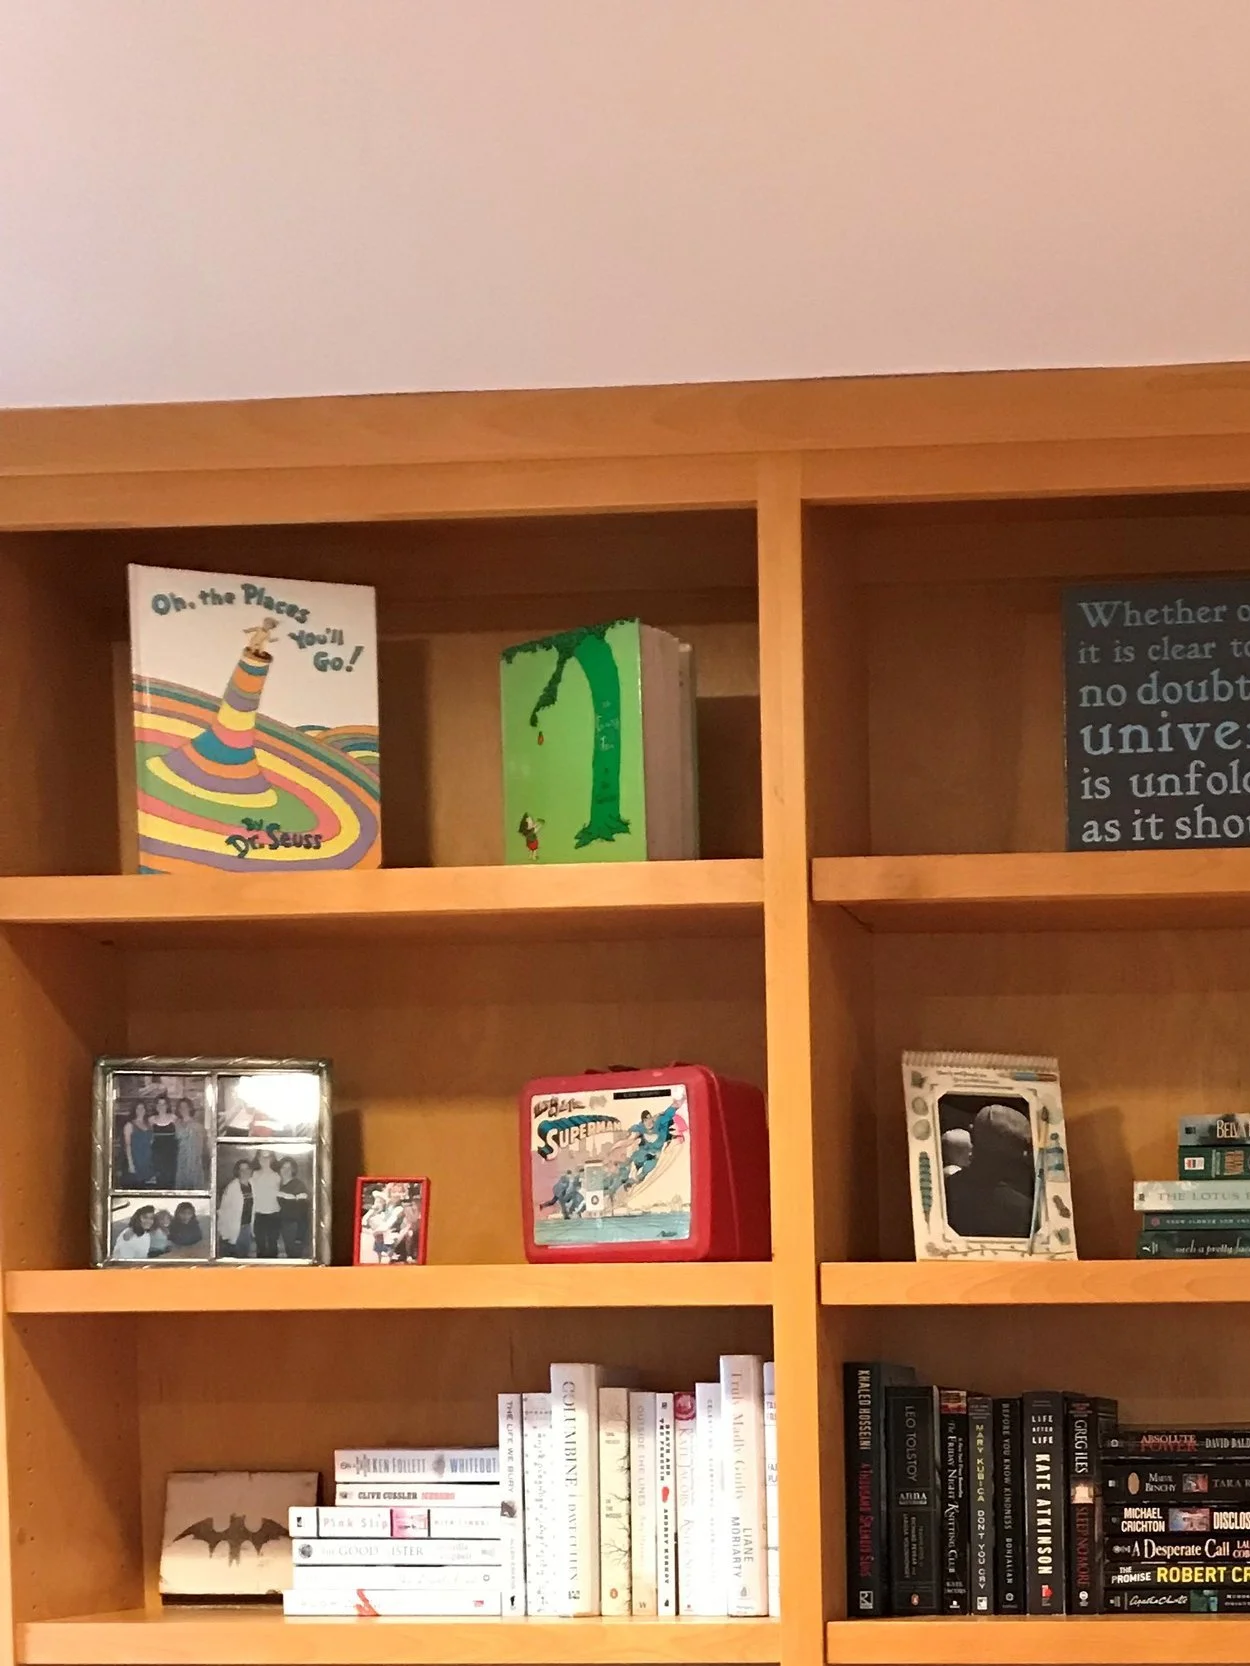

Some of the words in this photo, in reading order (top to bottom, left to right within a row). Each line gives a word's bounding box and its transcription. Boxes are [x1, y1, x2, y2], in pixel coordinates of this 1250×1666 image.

[151, 592, 196, 616] Oh,
[199, 587, 236, 606] the
[240, 583, 311, 624] Places
[1077, 599, 1228, 629] Whether
[288, 628, 344, 649] You'll
[1078, 641, 1099, 664] it
[1113, 639, 1136, 663] is
[1147, 636, 1217, 661] clear
[313, 646, 365, 673] Go!
[1078, 683, 1127, 707] no
[1080, 767, 1111, 800] is
[225, 834, 265, 858] Dr.
[266, 822, 322, 850] Seuss
[1081, 818, 1121, 843] as
[1132, 809, 1163, 841] it
[545, 1120, 622, 1162] SUPERMAN
[730, 1370, 743, 1406] Truly
[904, 1405, 916, 1428] LEO
[1031, 1414, 1053, 1423] LIFE
[562, 1380, 578, 1487] COLUMBINE
[732, 1413, 744, 1456] Madly
[1032, 1436, 1053, 1444] LIFE
[1073, 1420, 1088, 1449] GREG
[1140, 1434, 1197, 1444] ABSOLUTE
[372, 1458, 390, 1473] KEN
[392, 1458, 426, 1473] FOLLETT
[449, 1457, 497, 1474] WHITEOUT
[905, 1432, 917, 1481] TOLSTOY
[1075, 1452, 1089, 1474] ILES
[732, 1459, 746, 1501] Guilty
[1035, 1453, 1051, 1491] KATE
[358, 1491, 381, 1500] CLIVE
[383, 1491, 418, 1500] CUSSLER
[568, 1503, 577, 1532] DAVE
[1121, 1520, 1166, 1533] CRICHTON
[1124, 1508, 1163, 1519] MICHAEL
[730, 1516, 742, 1578] MORIARTY
[742, 1527, 754, 1563] LIANE
[1036, 1498, 1053, 1575] ATKINSON
[1131, 1540, 1141, 1557] A
[1144, 1538, 1202, 1560] Desperate
[1204, 1538, 1230, 1558] Call
[568, 1535, 578, 1581] CULLEN
[1119, 1565, 1132, 1574] THE
[1111, 1572, 1152, 1585] PROMISE
[1156, 1566, 1227, 1583] ROBERT
